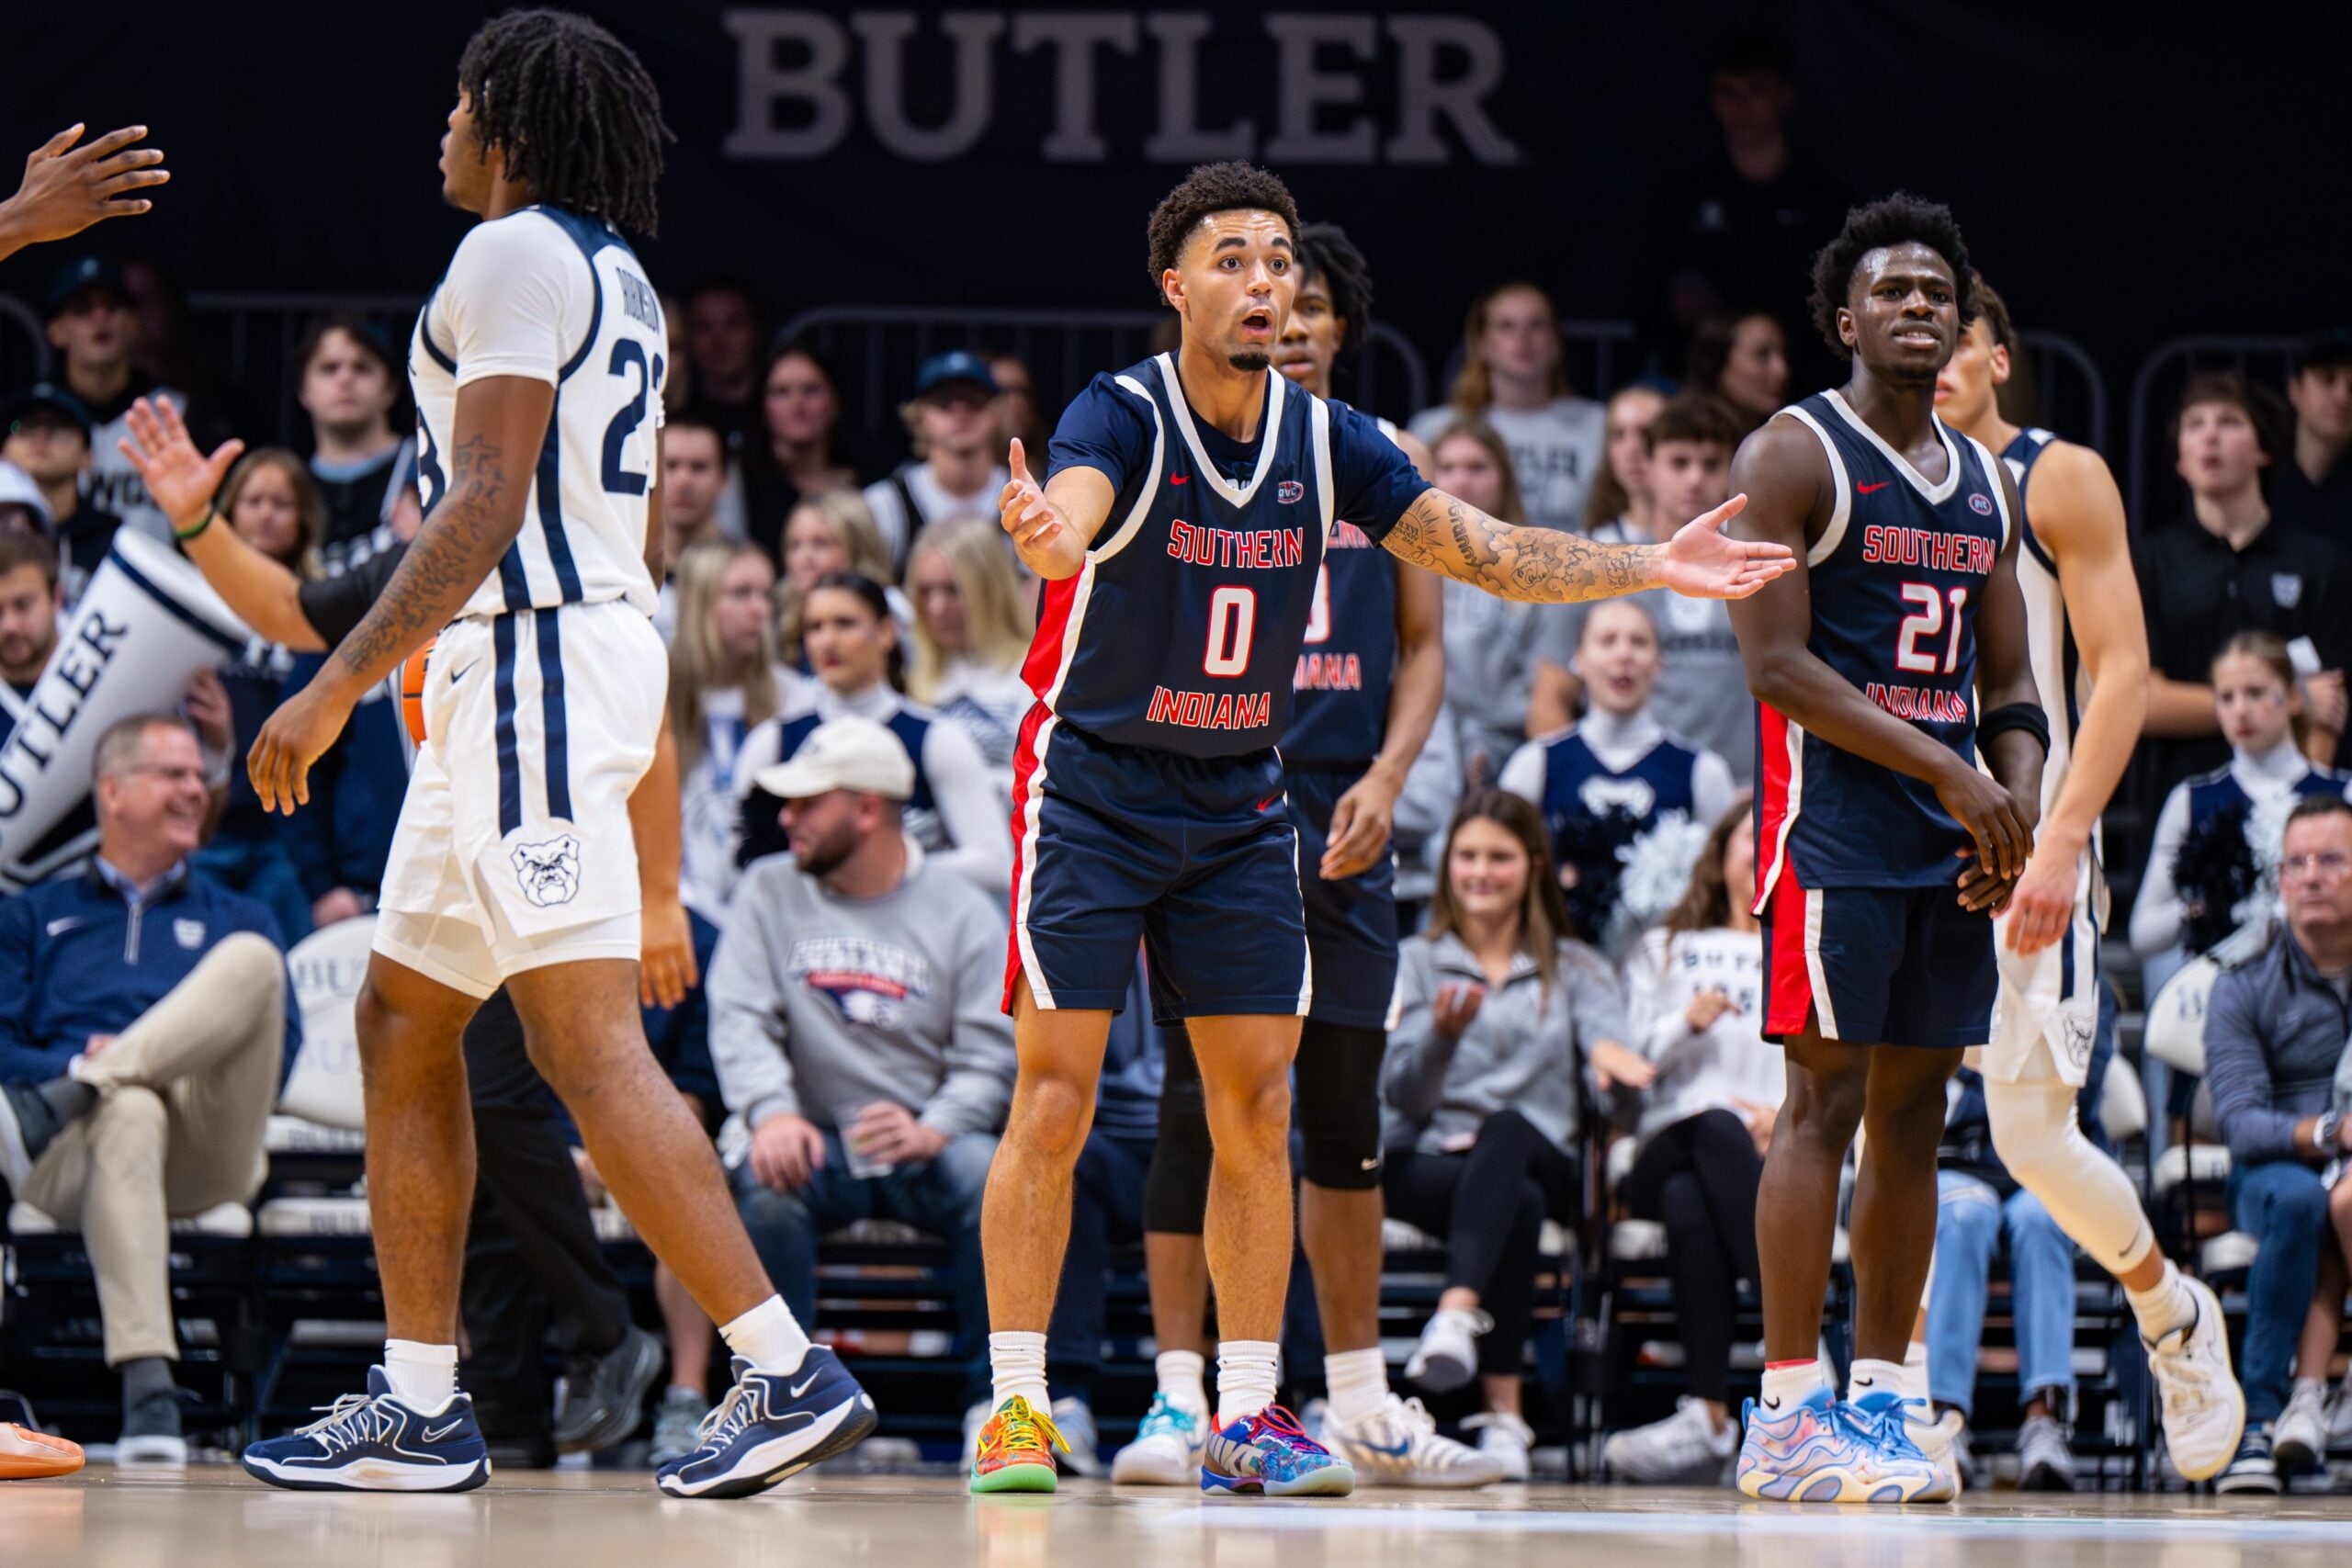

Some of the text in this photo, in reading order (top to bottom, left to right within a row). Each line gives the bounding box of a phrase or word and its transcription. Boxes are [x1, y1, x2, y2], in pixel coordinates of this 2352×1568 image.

[723, 12, 1525, 164] BUTLER
[1167, 519, 1304, 569] SOUTHERN
[1447, 502, 1481, 569] Granny
[1863, 525, 1996, 575] SOUTHERN
[1202, 584, 1257, 678] 0
[1895, 581, 1968, 675] 21
[1293, 653, 1362, 691] IANA
[0, 613, 129, 818] UTLER
[1147, 685, 1271, 730] INDIANA
[1866, 682, 1968, 724] INDIANA
